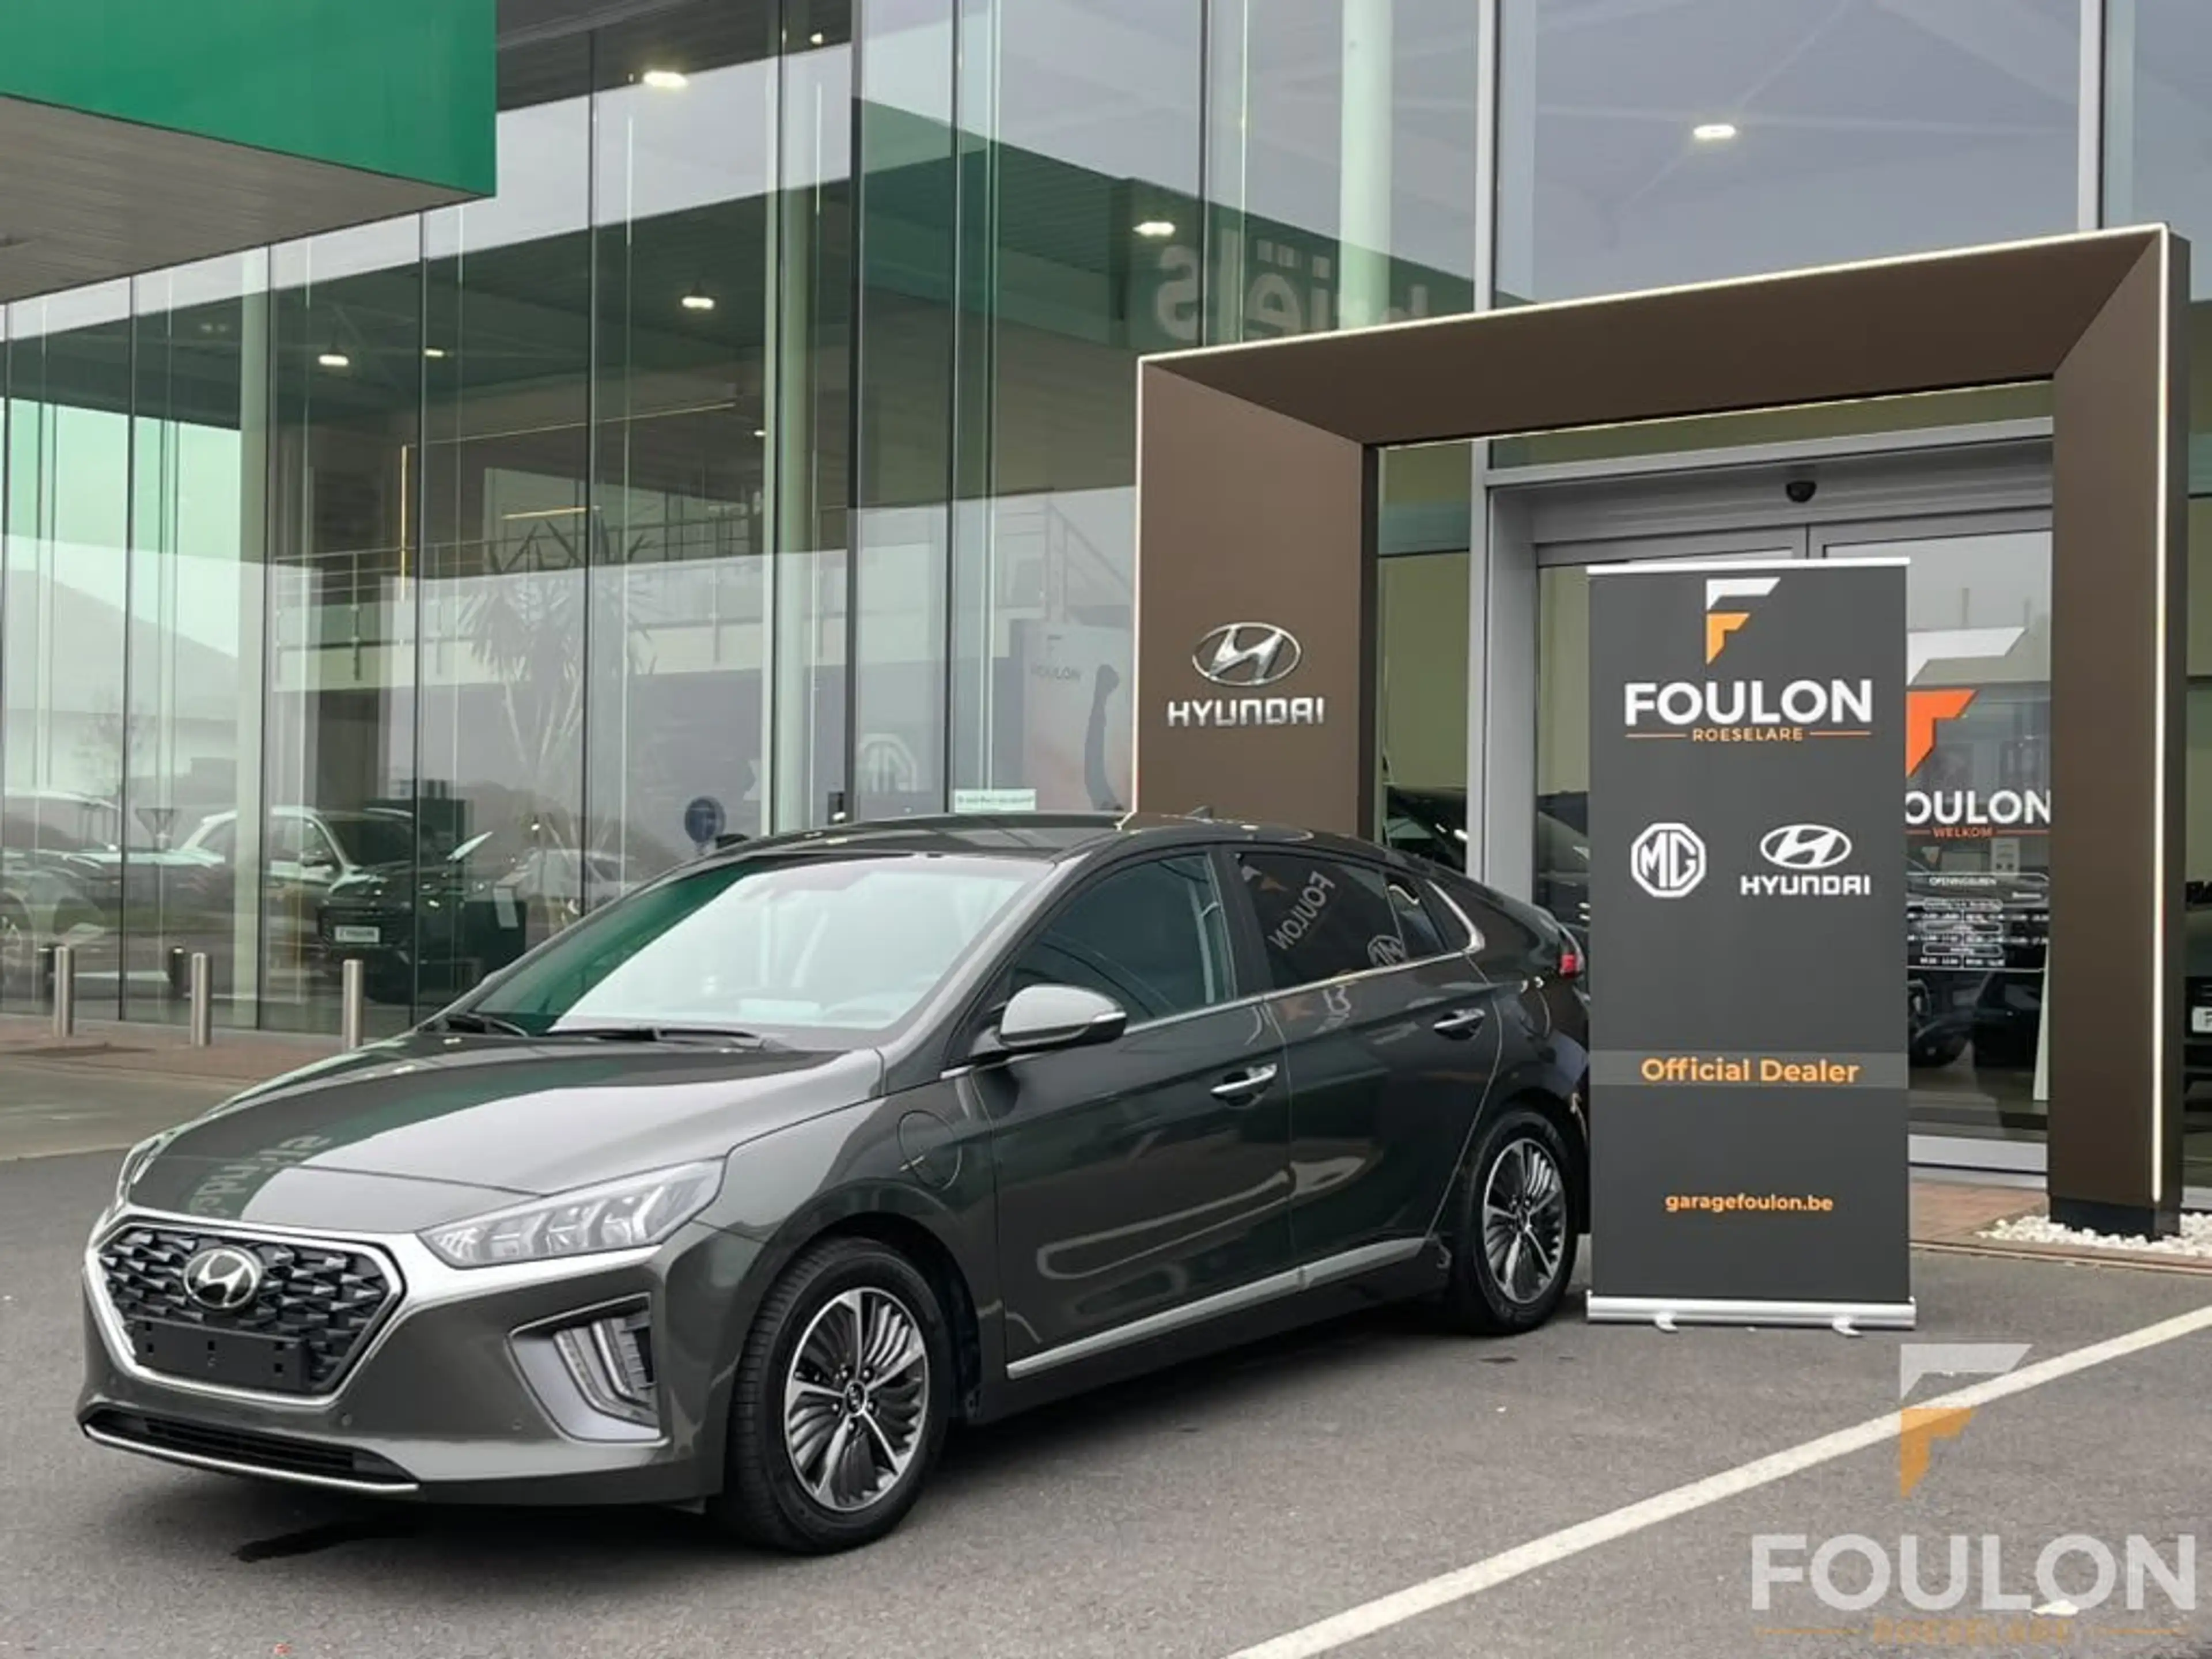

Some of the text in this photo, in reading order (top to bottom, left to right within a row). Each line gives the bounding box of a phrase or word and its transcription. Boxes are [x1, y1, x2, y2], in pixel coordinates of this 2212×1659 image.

[1167, 697, 1325, 727] HYUNDAI
[1624, 679, 1872, 726] FOULON
[1692, 727, 1803, 742] ROESELARE
[1933, 826, 1994, 838] WELKOM
[1638, 830, 1699, 889] MG
[1740, 874, 1871, 896] HYUNDAI
[1641, 1057, 1860, 1084] Official Dealer
[1665, 1193, 1834, 1213] garagefoulon.be
